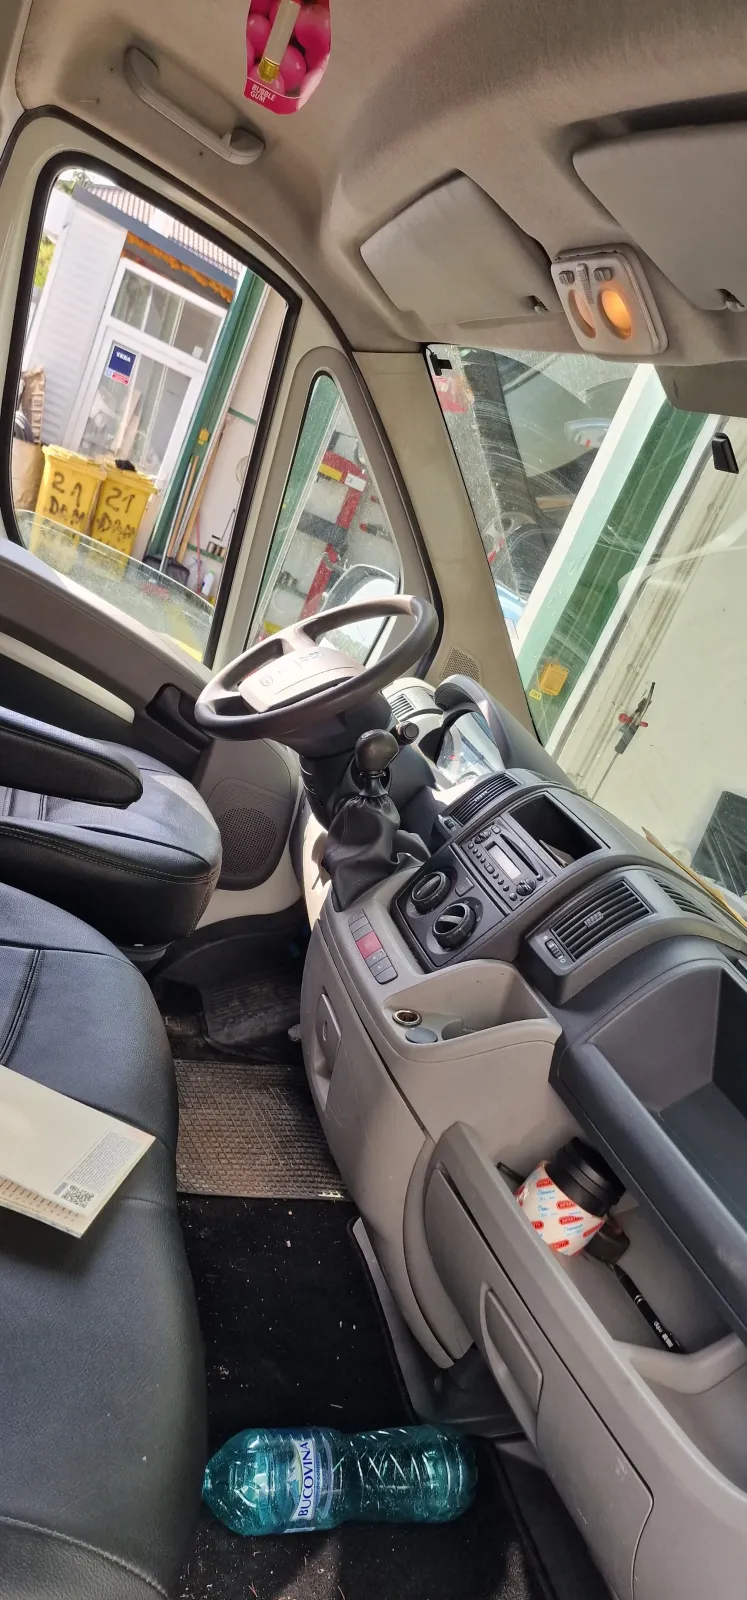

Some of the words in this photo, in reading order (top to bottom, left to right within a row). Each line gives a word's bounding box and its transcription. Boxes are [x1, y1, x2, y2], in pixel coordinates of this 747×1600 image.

[250, 91, 266, 102] GUM
[252, 84, 276, 102] BUBBLE
[105, 487, 136, 514] 21
[298, 1441, 314, 1517] BUCOVINA
